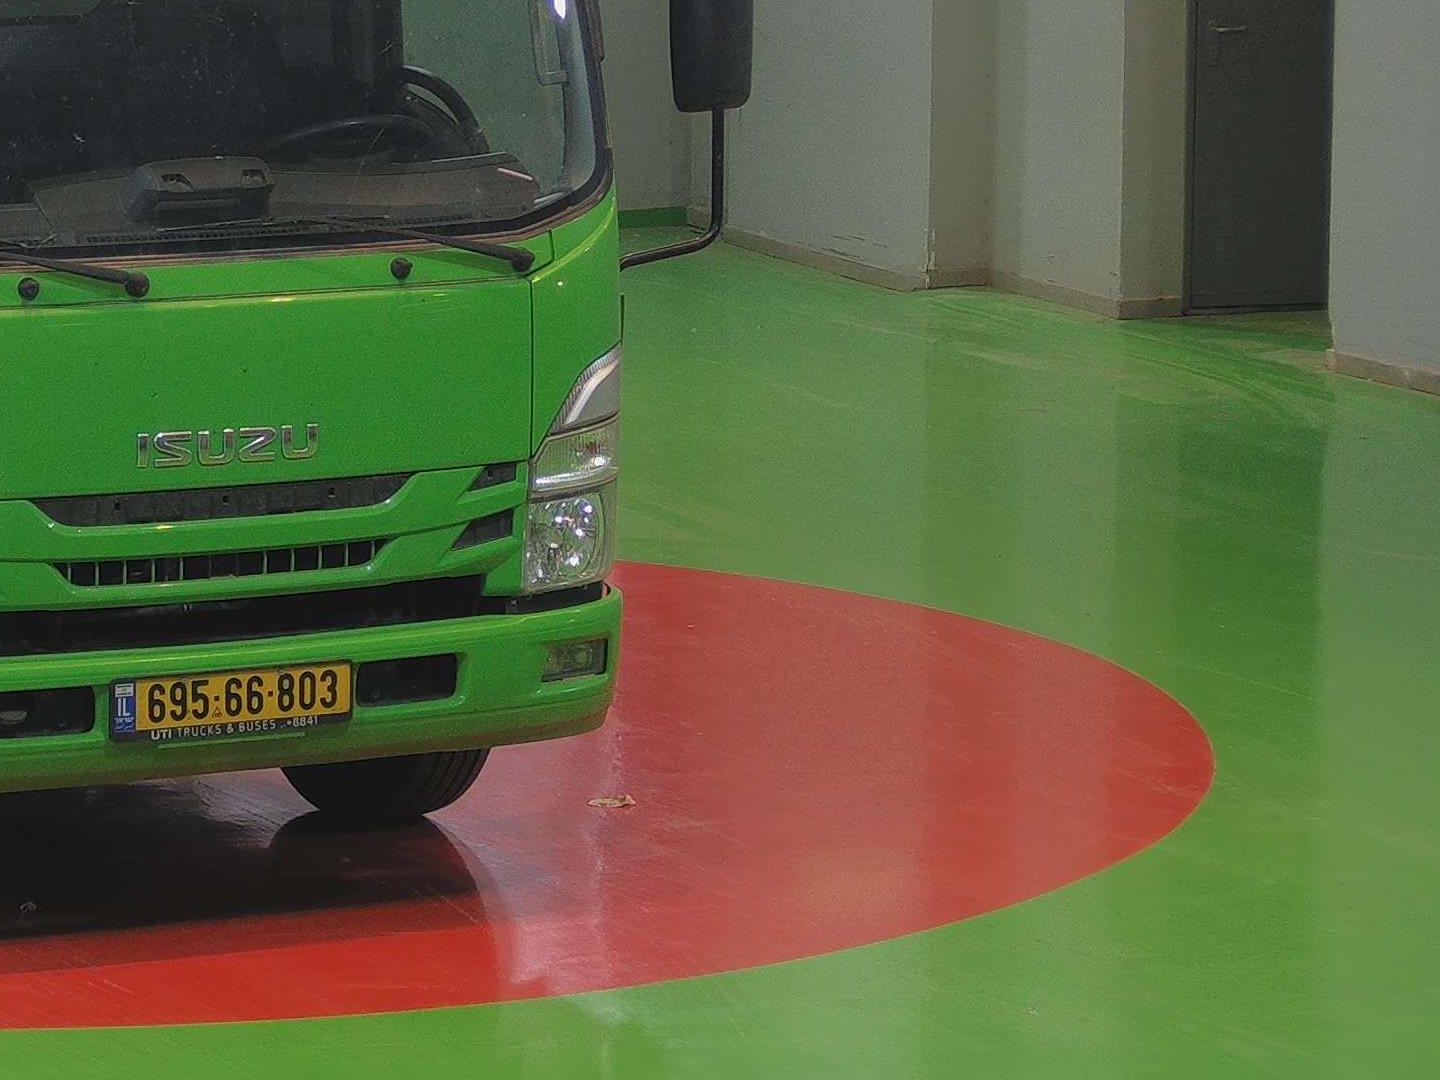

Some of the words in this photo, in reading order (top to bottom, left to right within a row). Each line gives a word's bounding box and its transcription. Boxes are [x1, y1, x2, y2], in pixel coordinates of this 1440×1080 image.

[137, 423, 319, 468] ISUZU
[117, 697, 131, 717] IL
[151, 728, 172, 740] UTI
[177, 723, 223, 738] TRUCKS
[226, 722, 234, 733] &
[238, 718, 276, 732] BUSES
